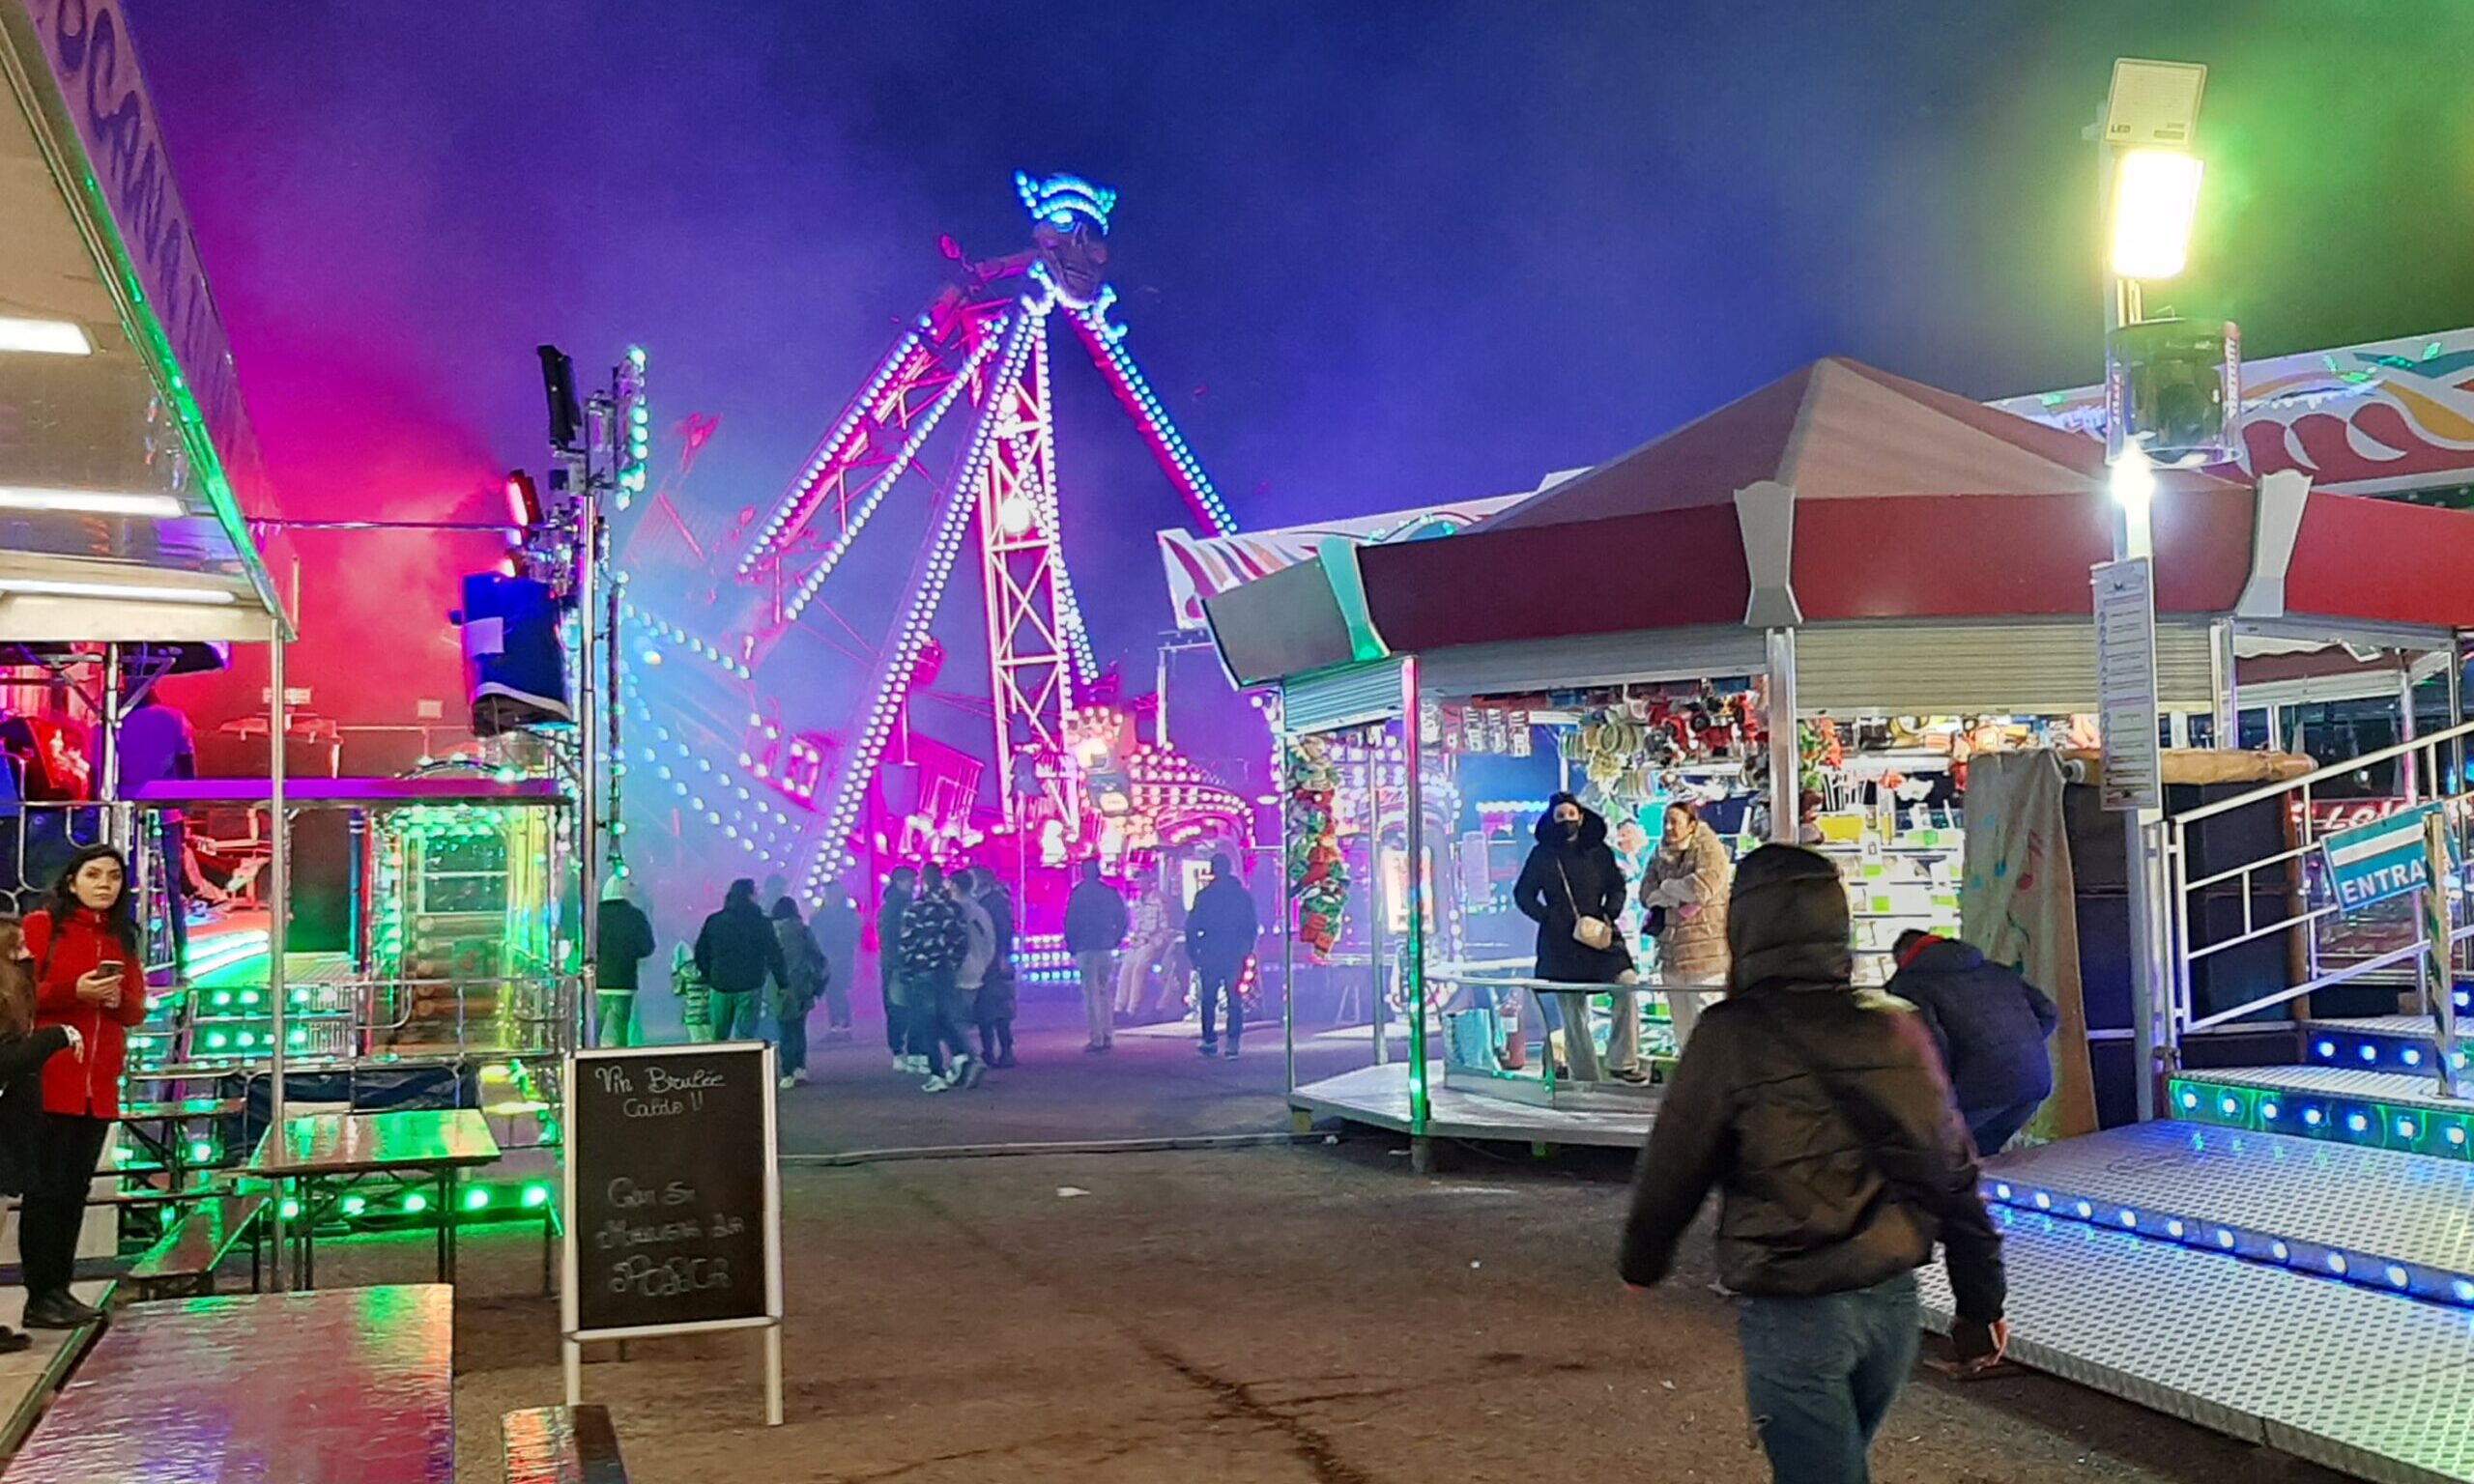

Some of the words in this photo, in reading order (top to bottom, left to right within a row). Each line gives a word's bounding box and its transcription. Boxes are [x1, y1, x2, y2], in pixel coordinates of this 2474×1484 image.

[2341, 854, 2431, 903] ENTRA
[595, 1065, 634, 1094] Vin
[622, 1097, 683, 1118] Caldo
